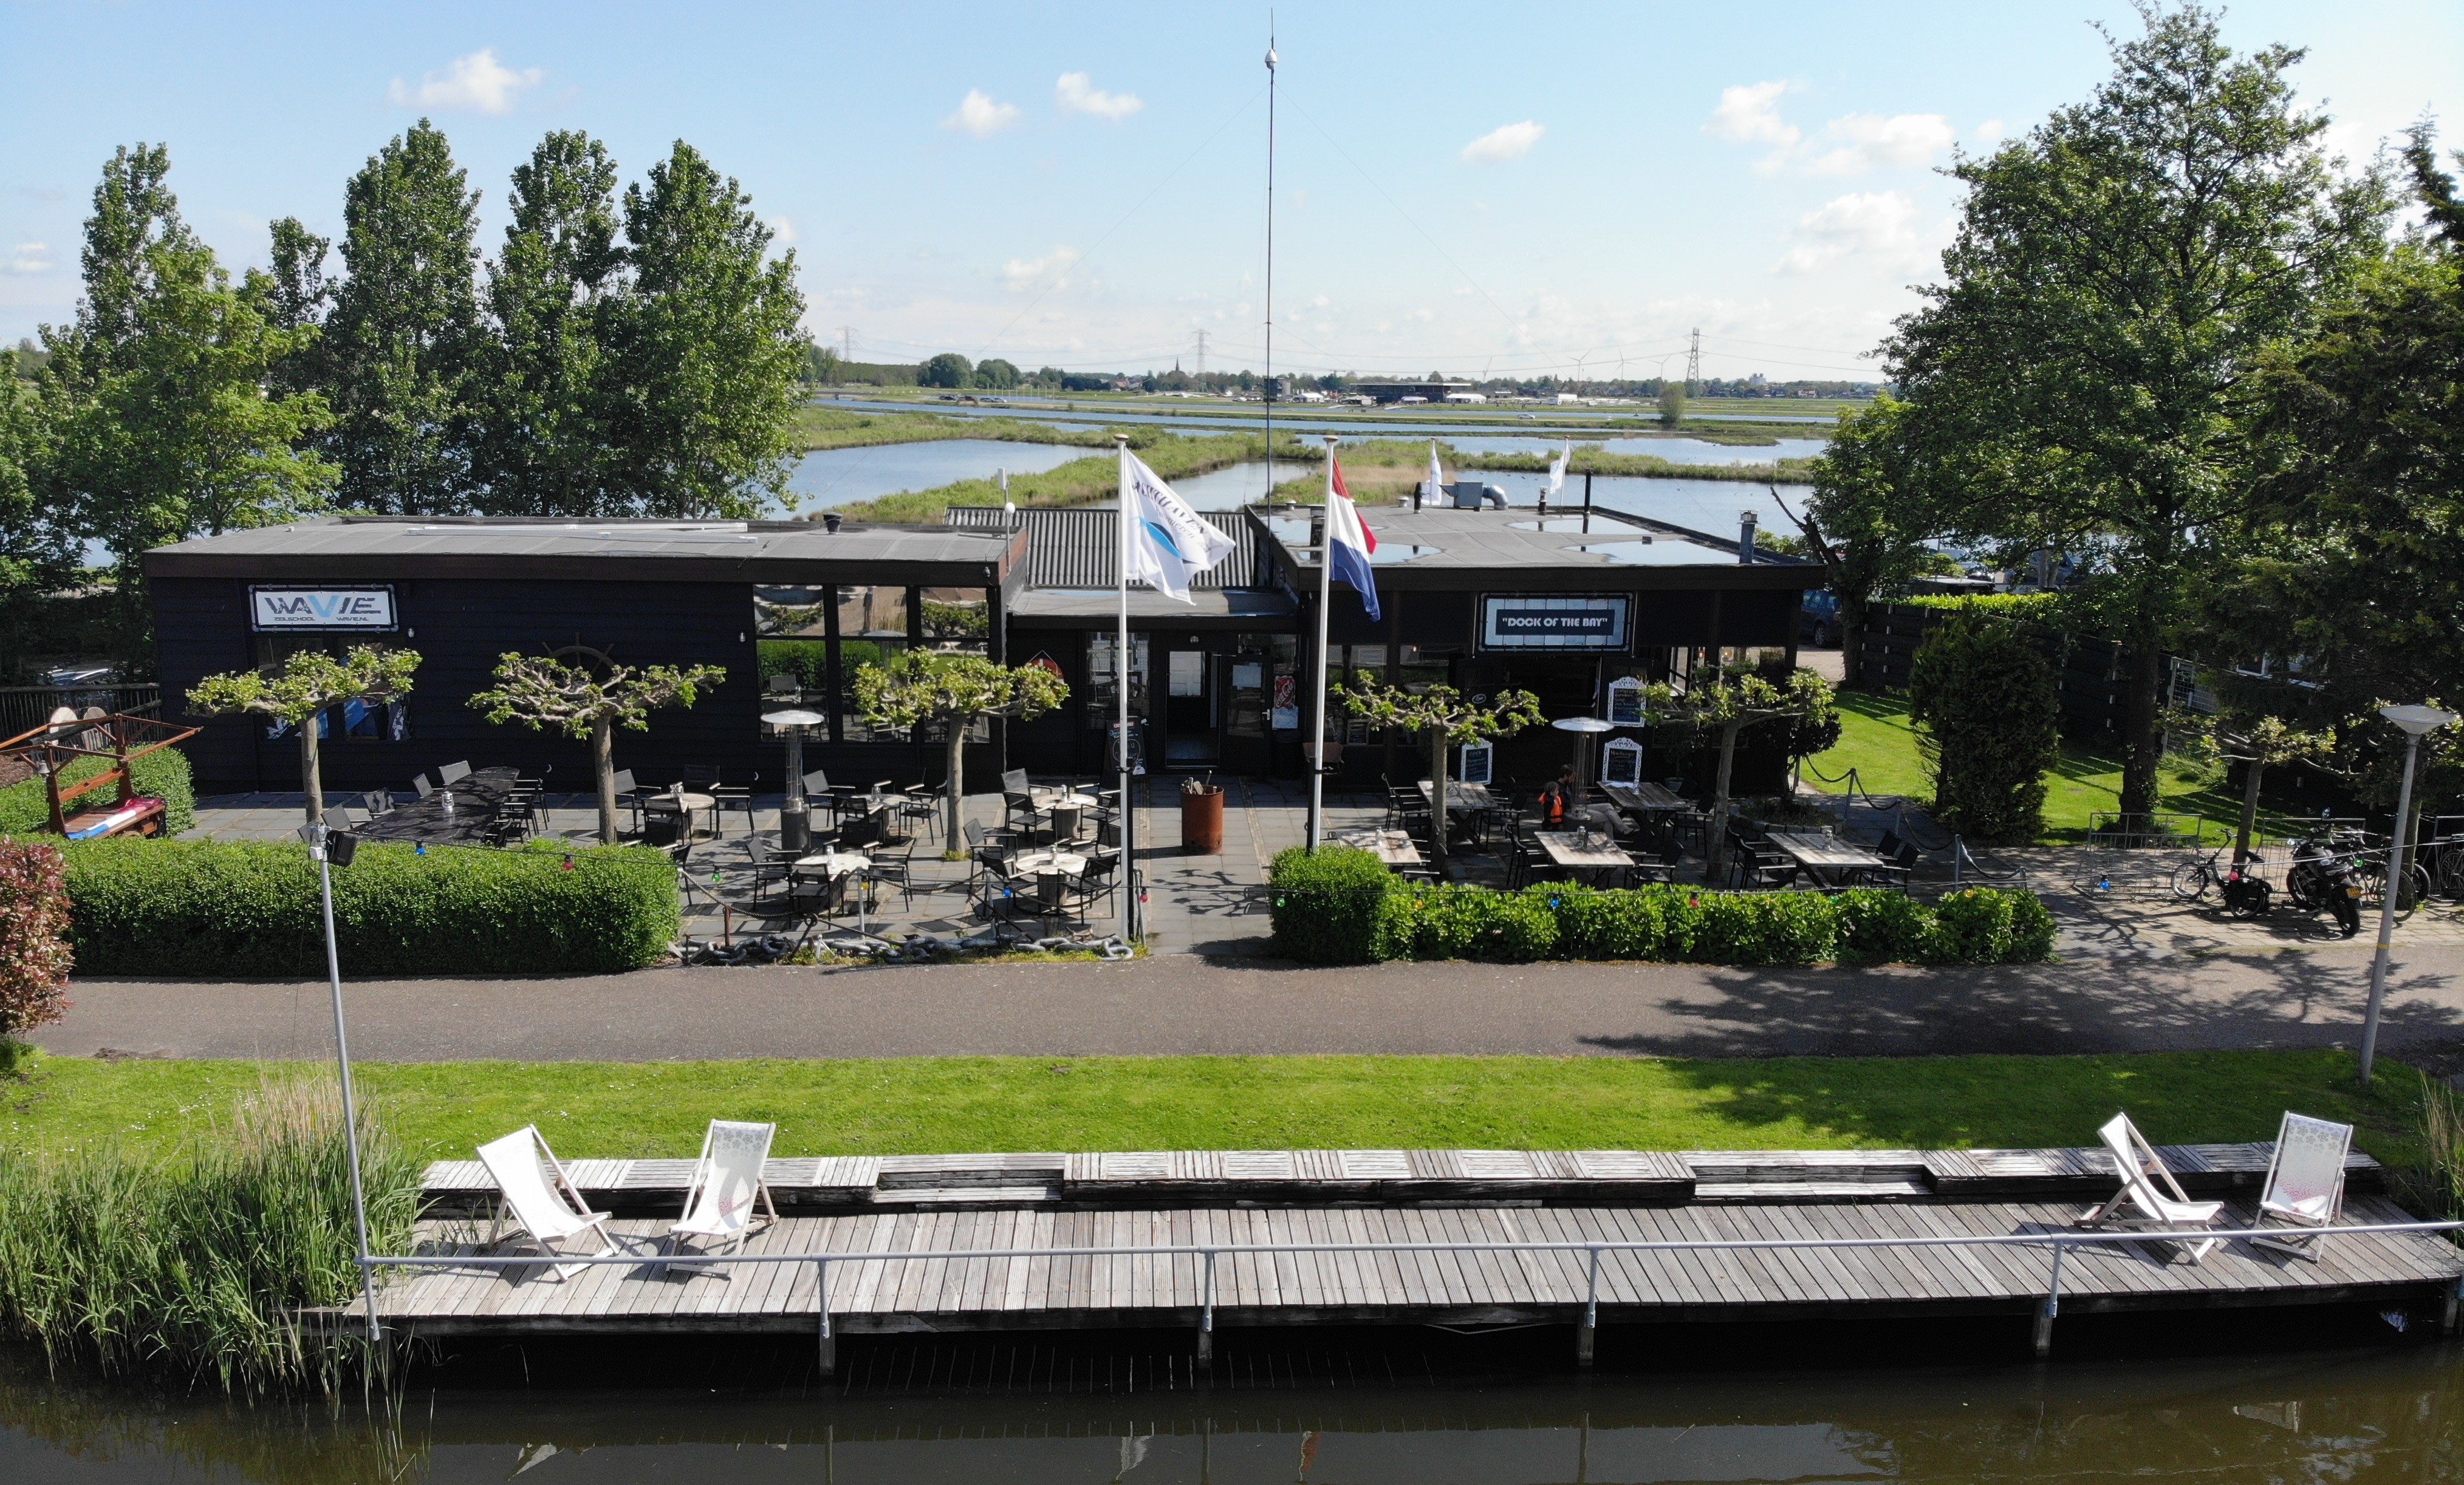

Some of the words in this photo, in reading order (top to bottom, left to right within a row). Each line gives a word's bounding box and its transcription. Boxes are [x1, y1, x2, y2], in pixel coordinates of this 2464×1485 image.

[264, 595, 381, 618] WAVIE
[1502, 618, 1541, 627] "DOCK
[1543, 618, 1559, 627] OF
[1561, 618, 1580, 627] THE
[1583, 618, 1608, 627] BAY"
